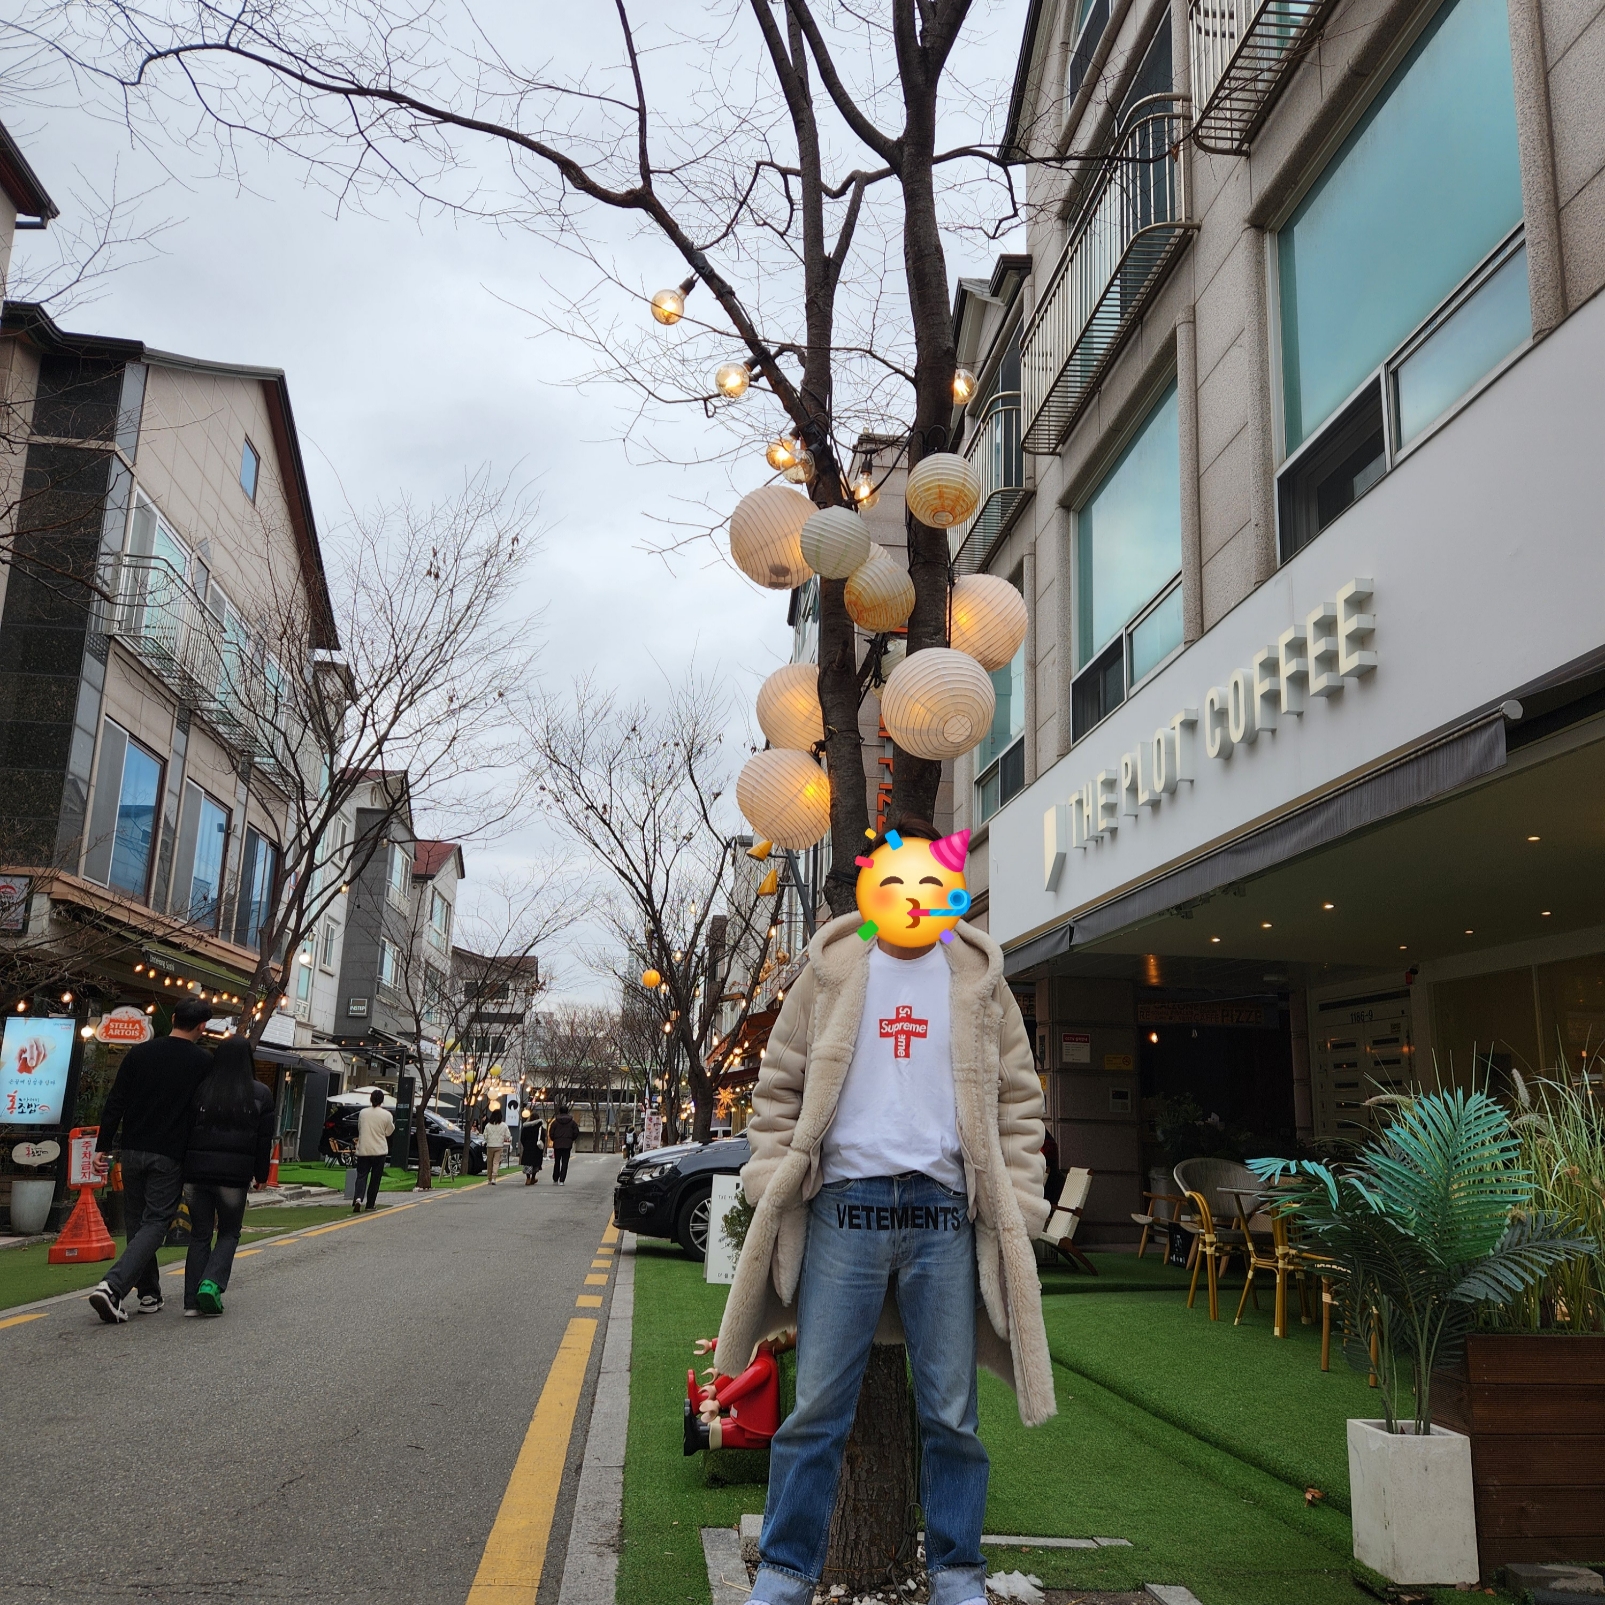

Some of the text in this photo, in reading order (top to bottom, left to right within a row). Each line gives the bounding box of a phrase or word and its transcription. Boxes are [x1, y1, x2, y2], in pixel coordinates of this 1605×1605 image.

[1069, 578, 1378, 849] THE PLOT COFFEE
[108, 1029, 140, 1037] ARTOIS
[110, 1022, 140, 1030] STELLA
[881, 1021, 926, 1036] Supreme
[81, 1141, 92, 1180] 주차금지
[836, 1203, 961, 1232] VETEMENTS
